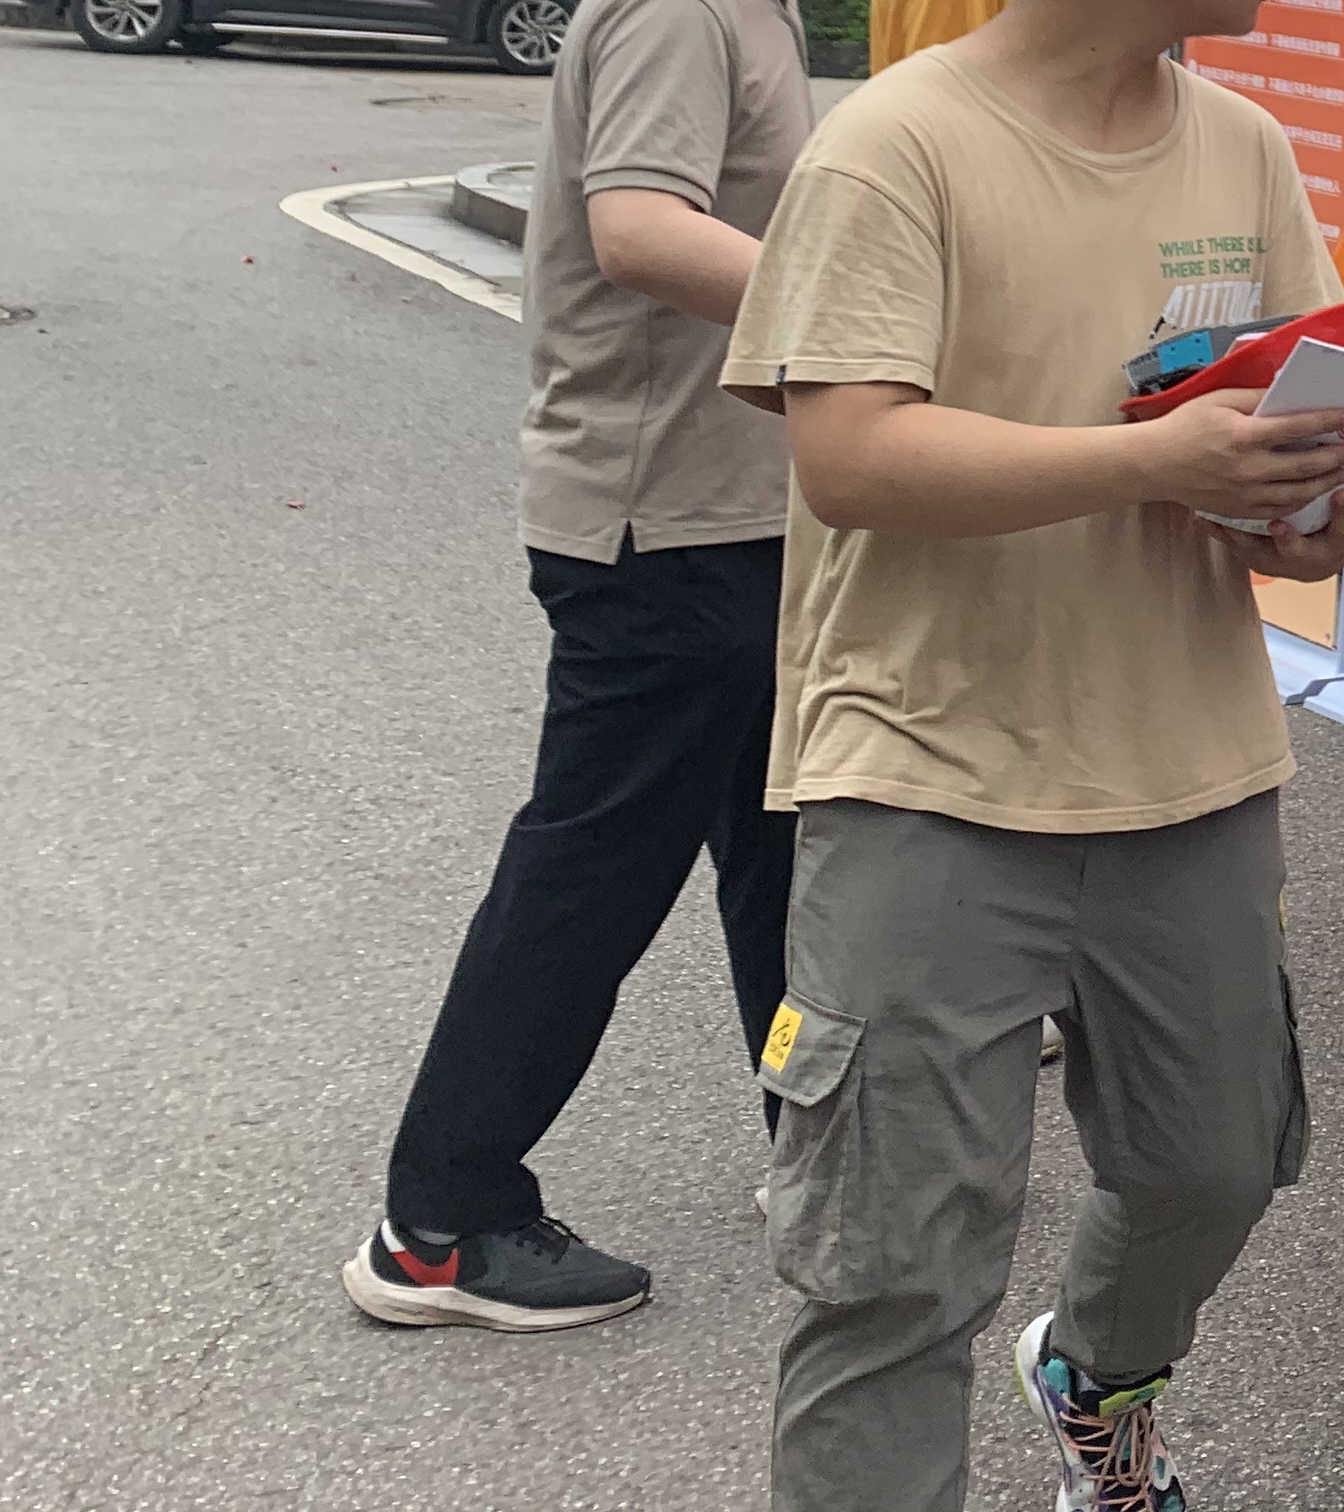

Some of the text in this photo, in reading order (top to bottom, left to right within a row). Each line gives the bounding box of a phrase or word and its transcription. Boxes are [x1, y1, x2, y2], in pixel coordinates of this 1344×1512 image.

[1158, 239, 1205, 257] WHILE
[1207, 237, 1244, 253] THERE
[1160, 260, 1206, 279] THERE
[1209, 259, 1220, 275] IS
